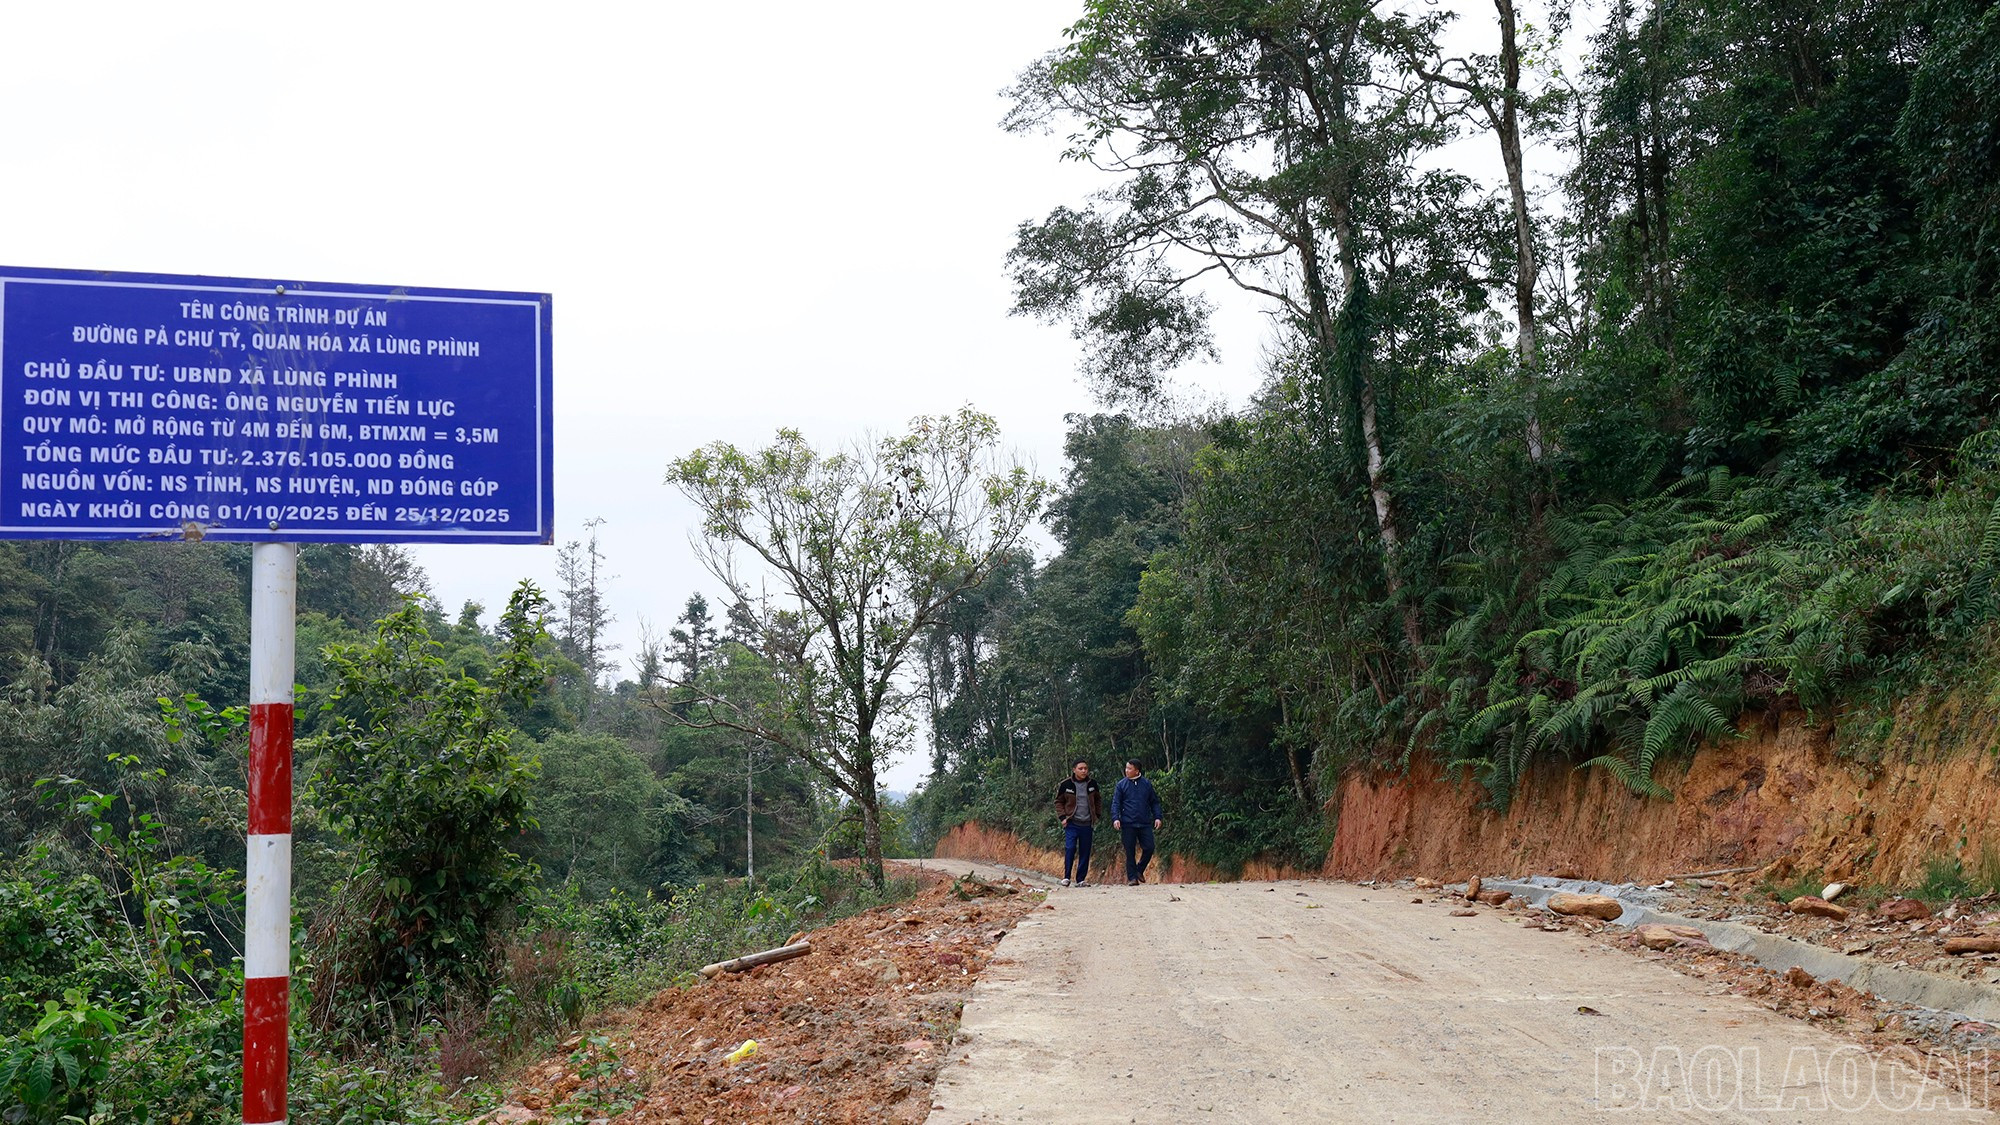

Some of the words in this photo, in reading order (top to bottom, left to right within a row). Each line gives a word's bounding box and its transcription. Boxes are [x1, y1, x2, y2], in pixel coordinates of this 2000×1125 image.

[180, 299, 213, 319] TÊN
[221, 301, 269, 323] CÔNG
[276, 304, 328, 324] TRÌNH
[335, 308, 359, 328] DỰ
[364, 307, 386, 326] ÁN
[73, 324, 137, 344] ĐƯỜNG
[145, 325, 168, 345] PẢ
[175, 329, 214, 347] CHƯ
[219, 328, 245, 353] TỶ,
[253, 330, 301, 350] QUAN
[307, 332, 343, 351] HÓA
[349, 334, 370, 352] XÃ
[377, 335, 420, 354] LÙNG
[427, 337, 479, 356] PHÌNH
[24, 359, 70, 378] CHỦ
[78, 359, 122, 380] ĐẦU
[131, 364, 164, 381] TƯ:
[174, 367, 231, 383] UBND
[239, 366, 265, 384] XÃ
[273, 367, 326, 386] LÙNG
[335, 370, 396, 388] PHÌNH
[24, 388, 70, 405] ĐƠN
[79, 391, 99, 410] VỊ
[108, 392, 143, 407] THI
[152, 390, 217, 409] CÔNG:
[226, 392, 268, 411] ÔNG
[277, 393, 357, 413] NGUYỄN
[365, 395, 409, 414] TIẾN
[418, 399, 454, 419] LỰC
[24, 417, 62, 434] QUY
[70, 415, 106, 433] MÔ:
[115, 415, 145, 434] MỞ
[153, 417, 204, 438] RỘNG
[211, 418, 235, 436] TỪ
[241, 422, 269, 437] 4M
[276, 418, 312, 438] ĐẾN
[320, 424, 352, 442] 6M,
[360, 425, 425, 441] BTMXM
[456, 428, 498, 444] 3,5M
[23, 440, 81, 462] TỔNG
[91, 444, 140, 463] MỨC
[148, 443, 191, 464] ĐẦU
[200, 448, 233, 465] TƯ:
[242, 451, 391, 468] 2.376.105.000
[398, 449, 453, 469] ĐỒNG
[22, 468, 94, 490] NGUỒN
[103, 469, 152, 490] VỐN:
[161, 476, 187, 491] NS
[194, 472, 247, 495] TỈNH,
[256, 477, 281, 493] NS
[289, 475, 360, 497] HUYỆN,
[368, 479, 393, 494] ND
[400, 476, 453, 495] ĐÓNG
[461, 478, 498, 496] GÓP
[22, 500, 80, 517] NGÀY
[89, 500, 140, 518] KHỞI
[150, 501, 209, 518] CÔNG
[217, 505, 338, 521] 01/10/2025
[346, 502, 387, 520] ĐẾN
[395, 507, 510, 523] 25/12/2025
